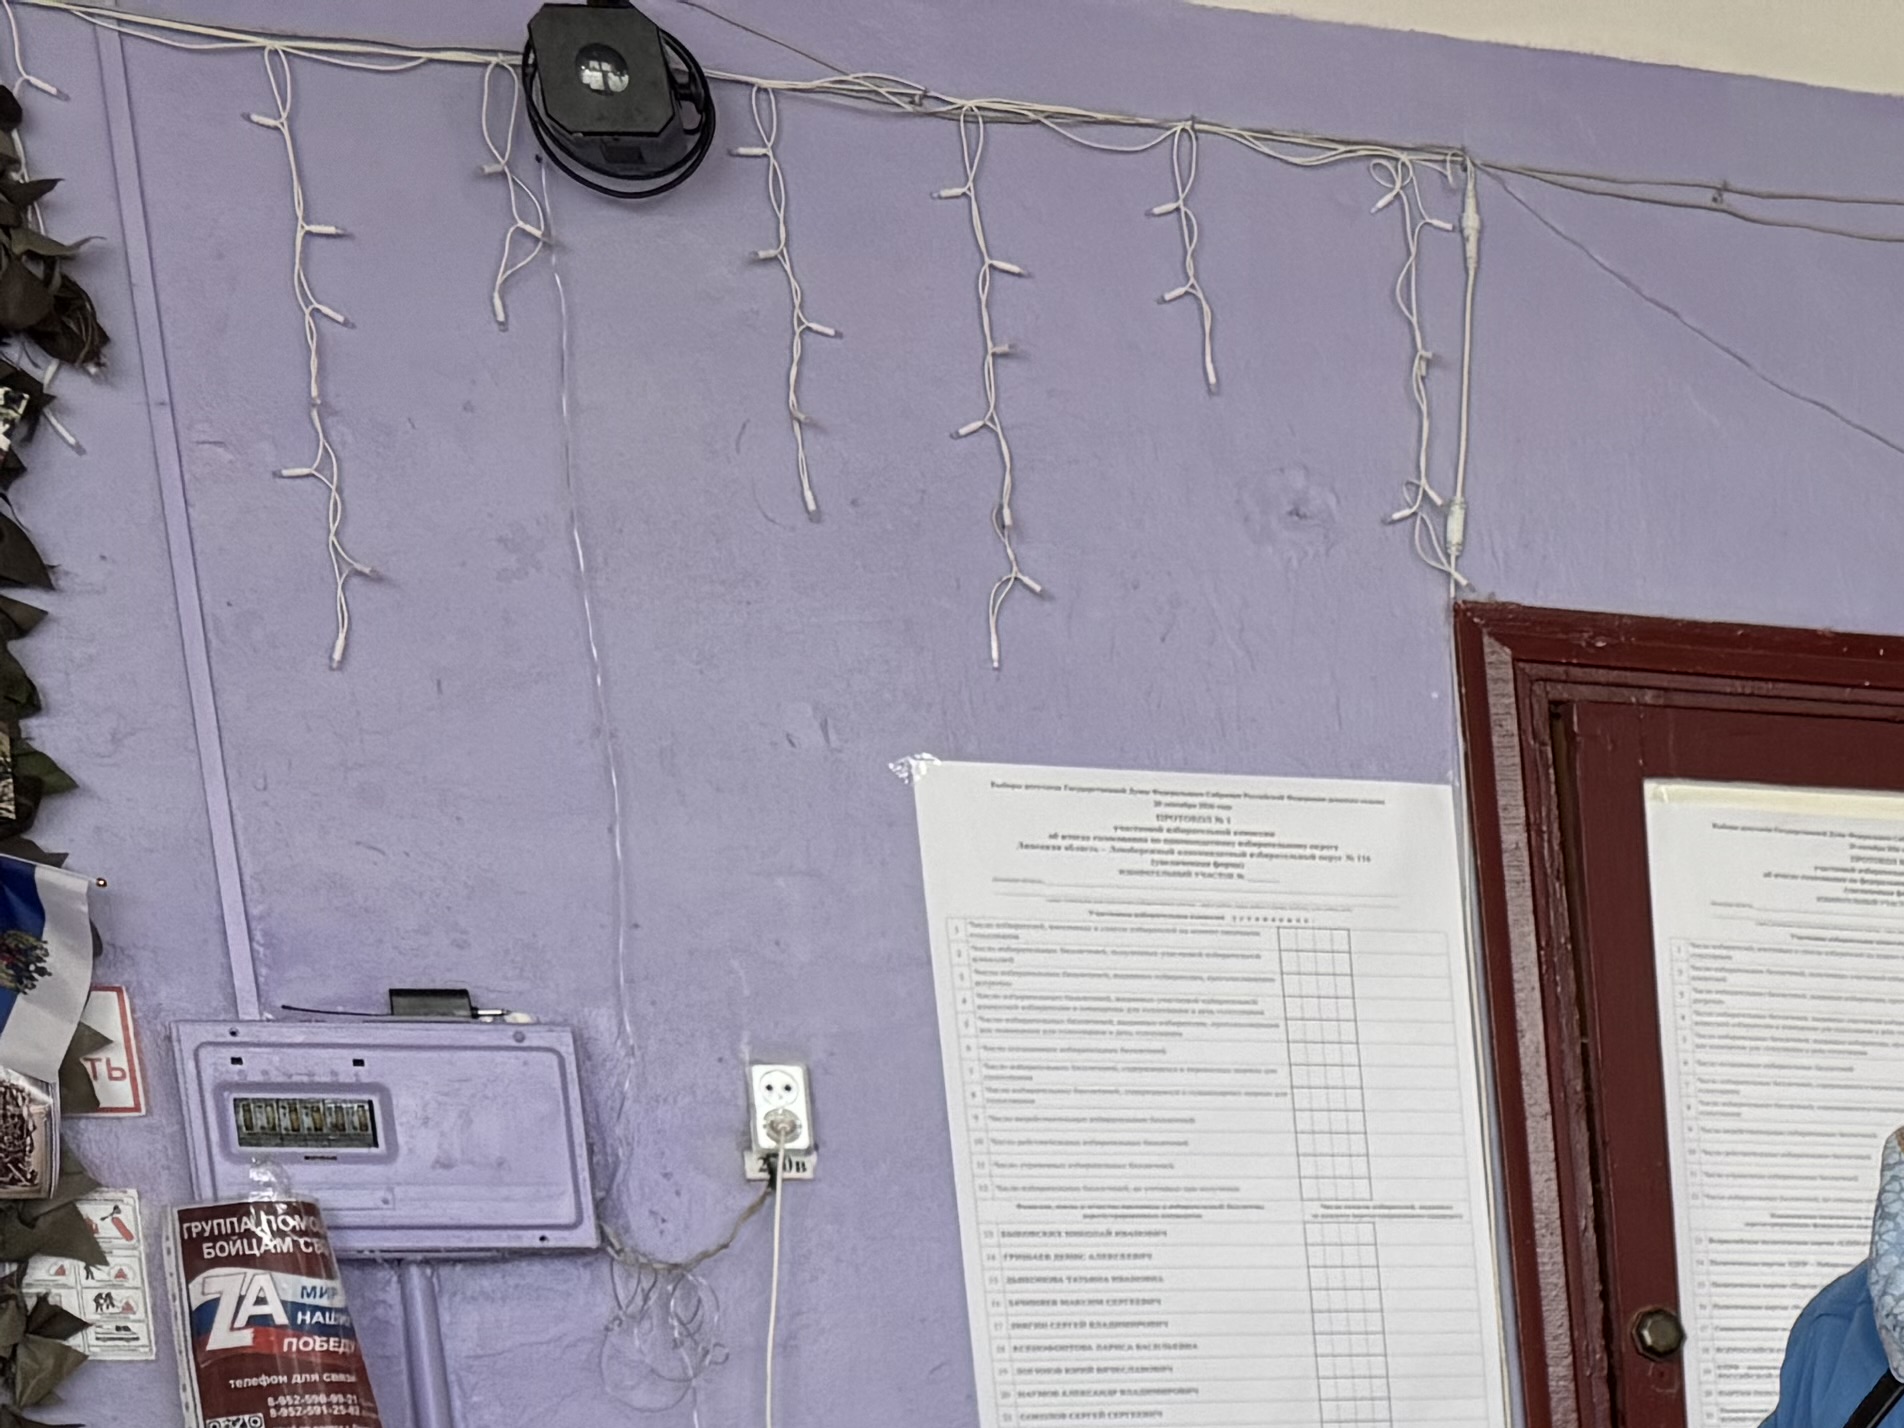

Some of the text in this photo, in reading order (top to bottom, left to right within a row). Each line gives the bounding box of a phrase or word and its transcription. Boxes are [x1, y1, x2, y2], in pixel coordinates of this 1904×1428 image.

[182, 1216, 252, 1239] ГРУППА
[202, 1235, 294, 1259] БОЙЦАМ
[228, 1374, 288, 1389] телефон
[291, 1372, 320, 1385] для
